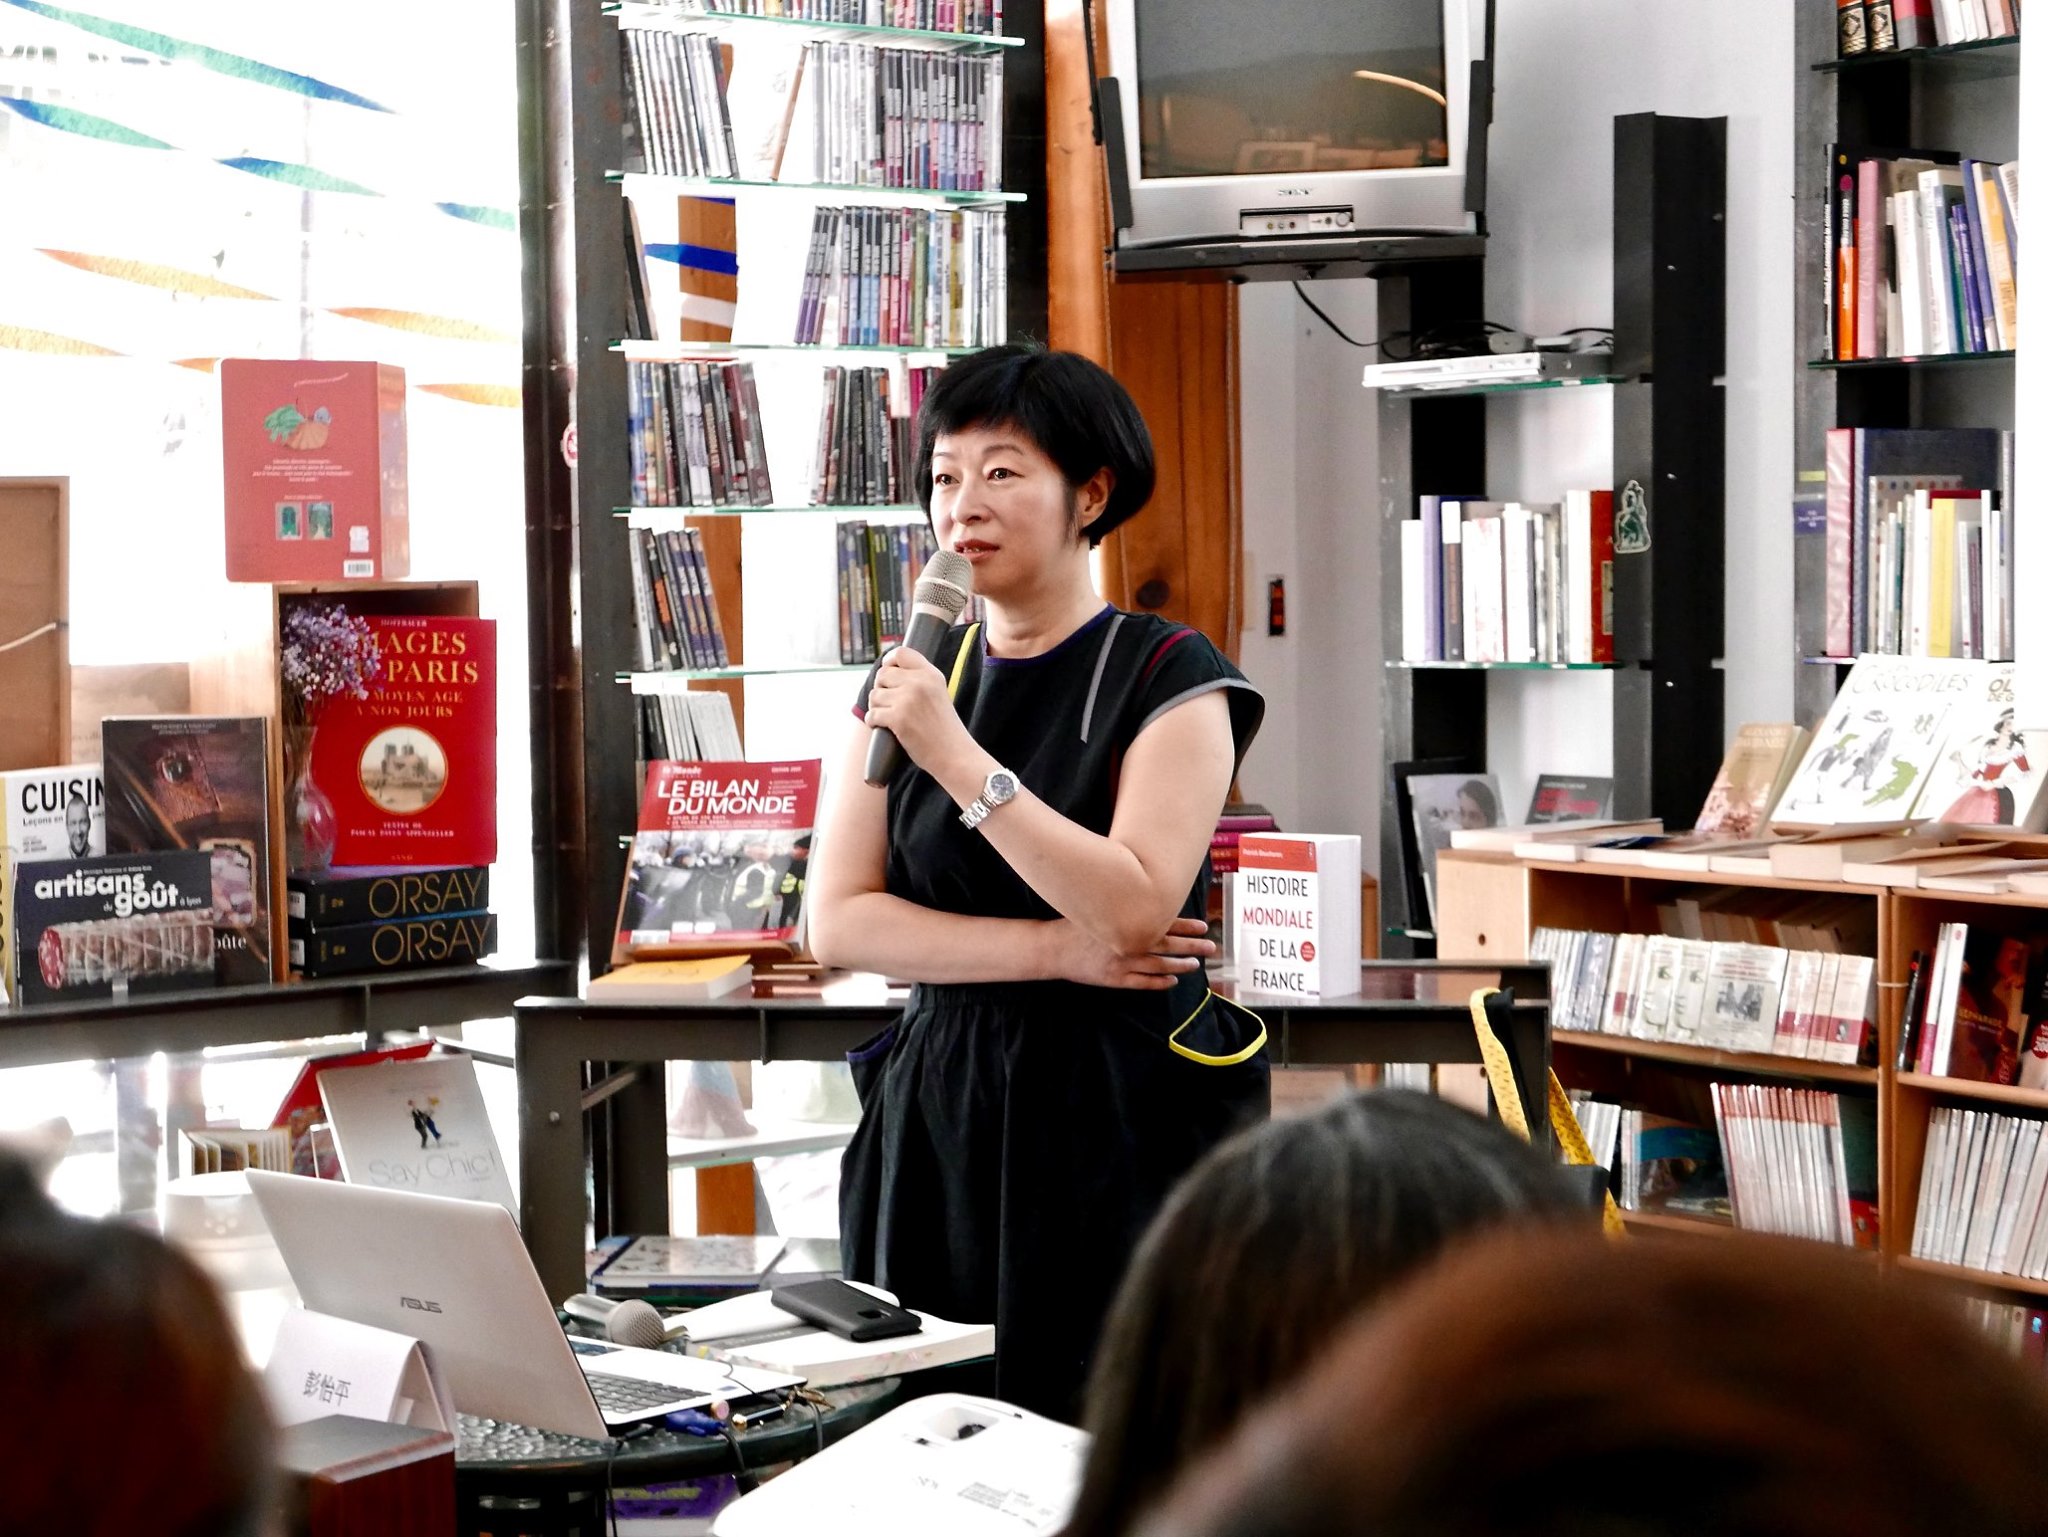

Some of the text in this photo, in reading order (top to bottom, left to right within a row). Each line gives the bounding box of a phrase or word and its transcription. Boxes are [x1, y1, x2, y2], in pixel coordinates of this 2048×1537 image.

[388, 660, 478, 684] PARIS
[374, 690, 425, 702] MOYEN
[407, 704, 454, 718] JOURS
[658, 779, 687, 798] LE
[689, 779, 760, 798] BILAN
[667, 796, 798, 815] DU MONDE
[35, 869, 146, 899] artisans
[369, 872, 482, 918] ORSAY
[1246, 875, 1308, 897] HISTOIRE
[115, 880, 179, 917] goût
[1243, 906, 1314, 929] MONDIALE
[371, 917, 492, 966] ORSAY
[1259, 938, 1276, 957] DE
[1281, 940, 1298, 960] LA
[1253, 969, 1305, 992] FRANCE
[368, 1157, 421, 1187] Say
[400, 1297, 443, 1314] ASUS
